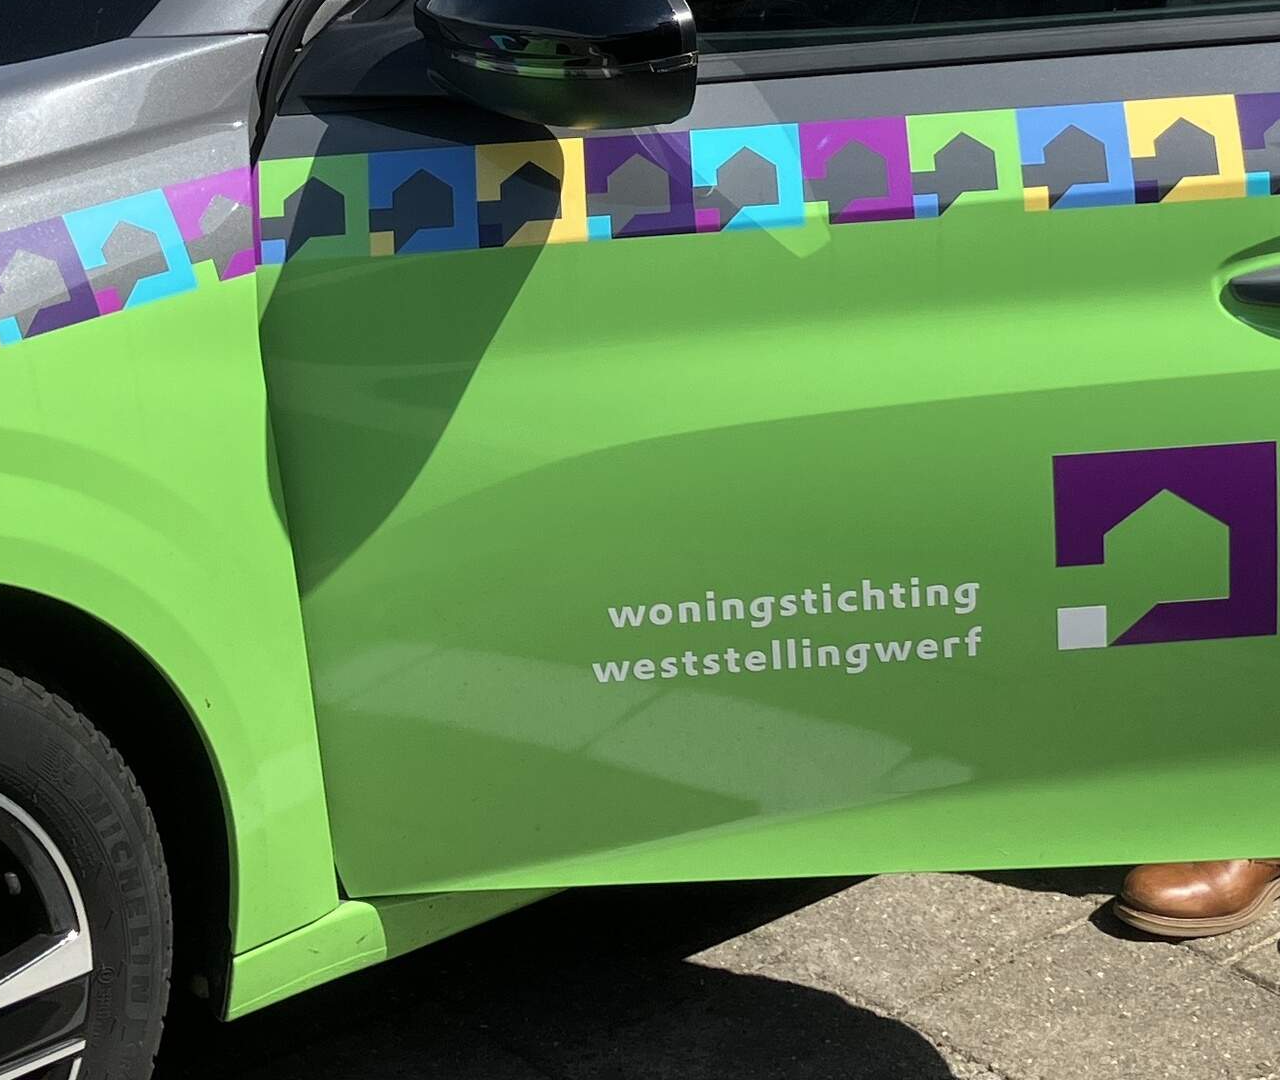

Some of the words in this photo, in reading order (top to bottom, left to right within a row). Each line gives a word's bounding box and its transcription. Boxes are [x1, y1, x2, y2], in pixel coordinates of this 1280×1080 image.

[608, 577, 980, 628] woningstichting
[592, 626, 983, 683] weststellingwerf
[80, 791, 151, 1003] MICHELIN
